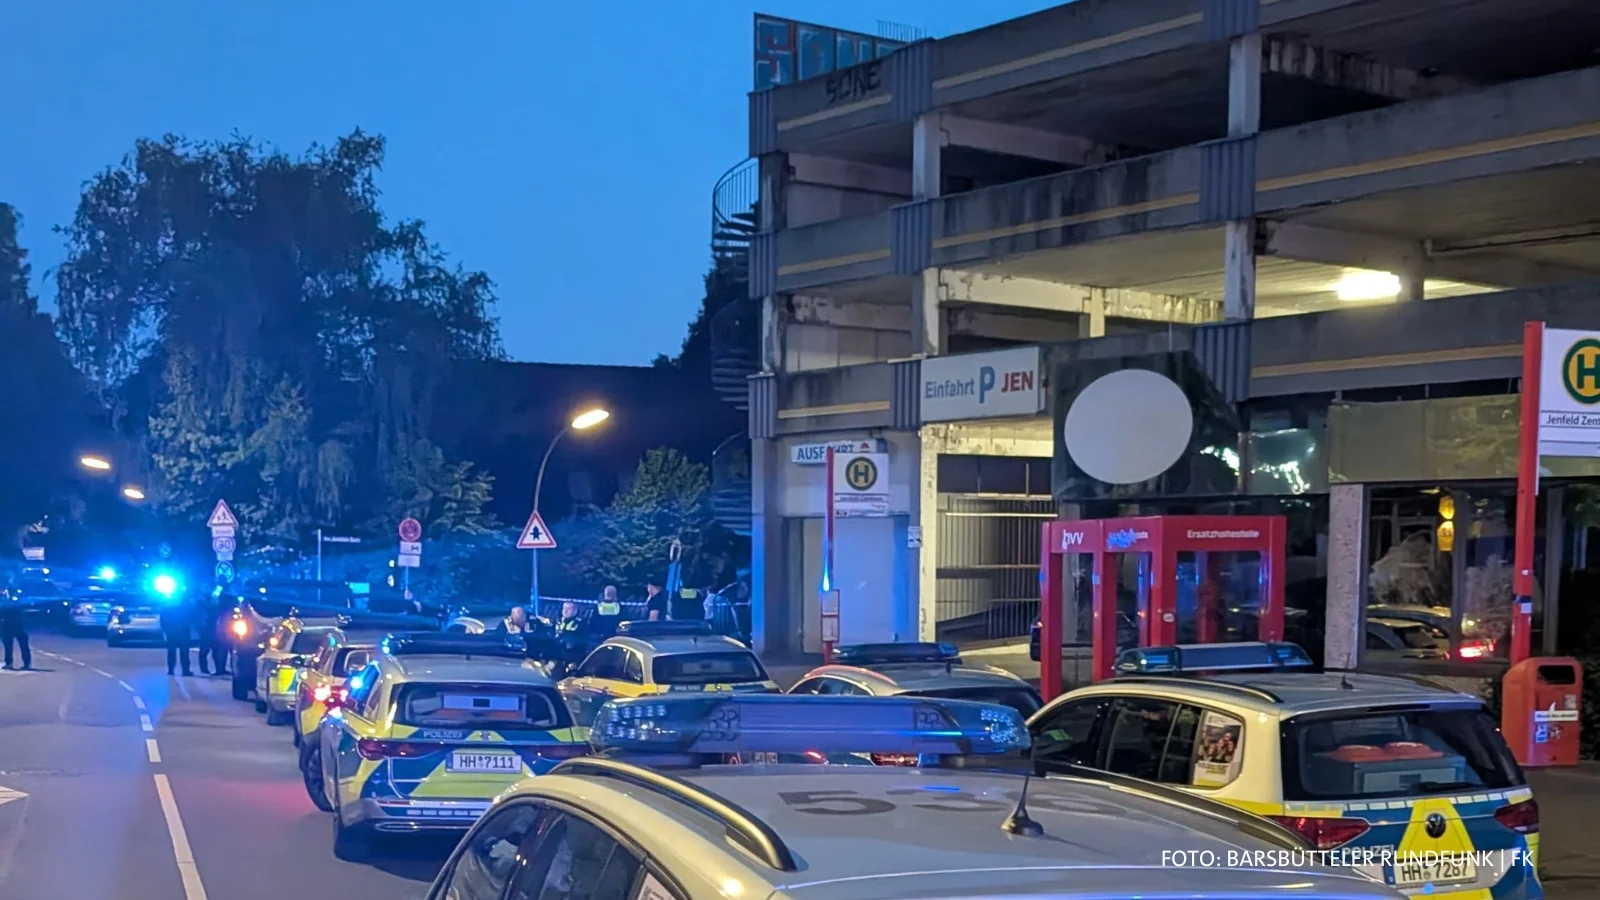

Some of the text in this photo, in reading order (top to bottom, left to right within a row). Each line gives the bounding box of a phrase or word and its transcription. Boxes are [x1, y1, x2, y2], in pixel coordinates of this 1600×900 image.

[925, 366, 1034, 404] Einfahrt P JEN
[1546, 415, 1580, 425] Jenfeld
[218, 539, 231, 550] 30
[423, 731, 463, 739] POLIZEI
[460, 756, 514, 769] HH 7111
[1401, 863, 1422, 881] HH
